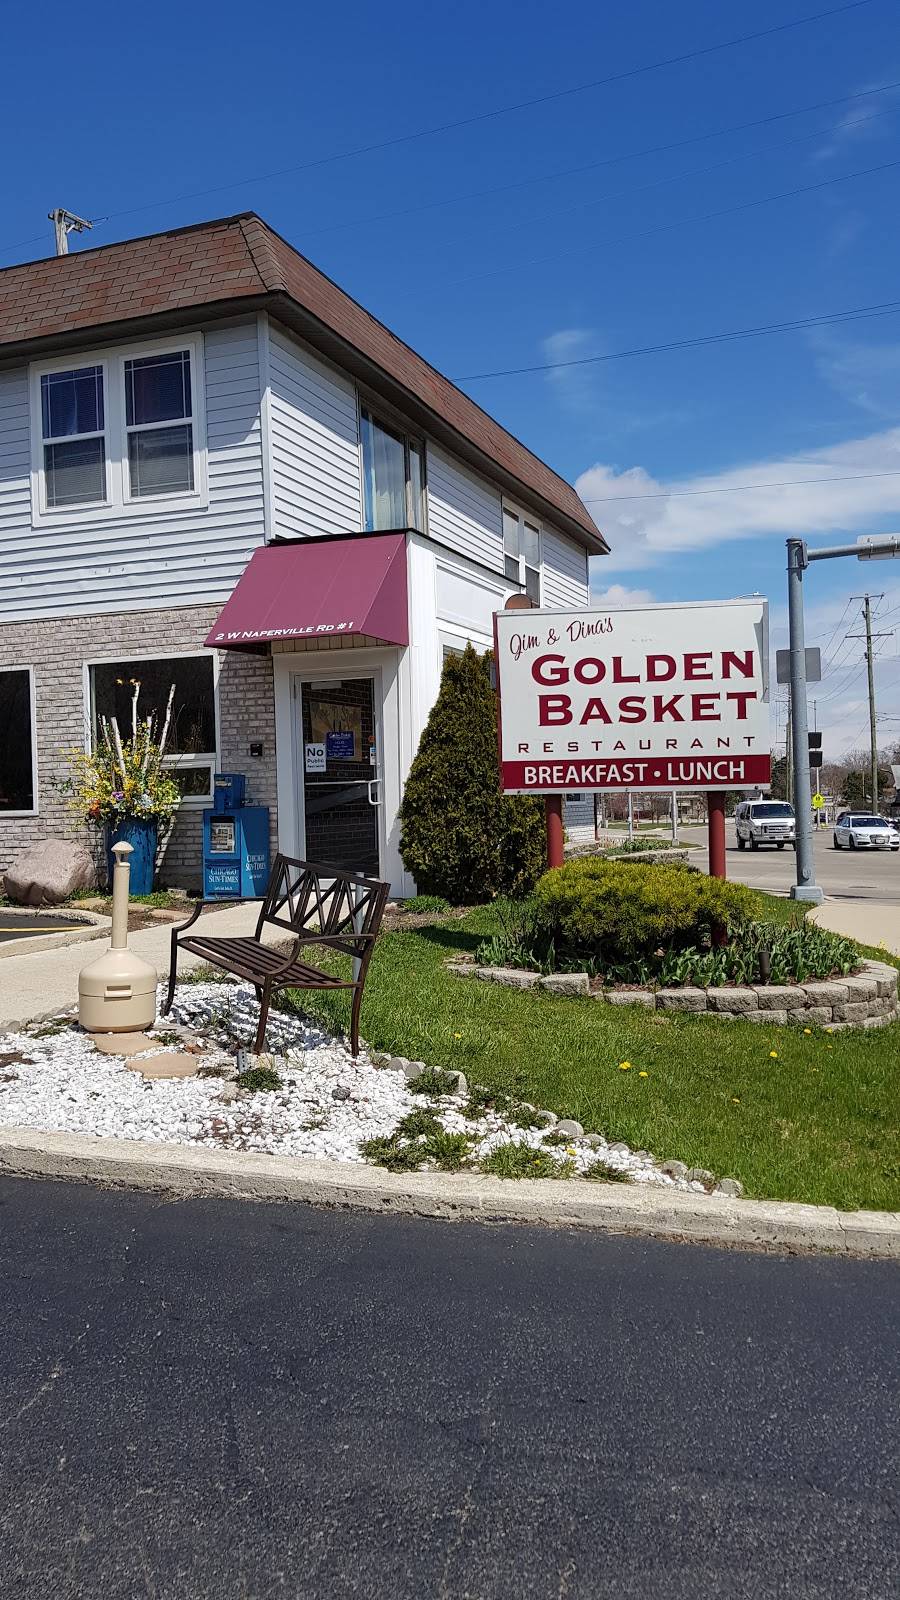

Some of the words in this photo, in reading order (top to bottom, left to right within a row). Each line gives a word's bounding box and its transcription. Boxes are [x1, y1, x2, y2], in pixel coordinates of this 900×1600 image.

[214, 633, 225, 641] 2
[227, 632, 242, 640] W
[241, 626, 315, 639] NAPERVILLE
[336, 621, 354, 630] #1
[509, 633, 541, 661] Jim
[546, 628, 561, 645] &
[566, 617, 614, 642] Dina's
[530, 650, 756, 687] GOLDEN
[537, 691, 758, 727] BASKET
[306, 747, 325, 758] No
[517, 736, 756, 754] RESTAURANT
[523, 762, 649, 785] BREAKFAST
[667, 760, 746, 781] LUNCH
